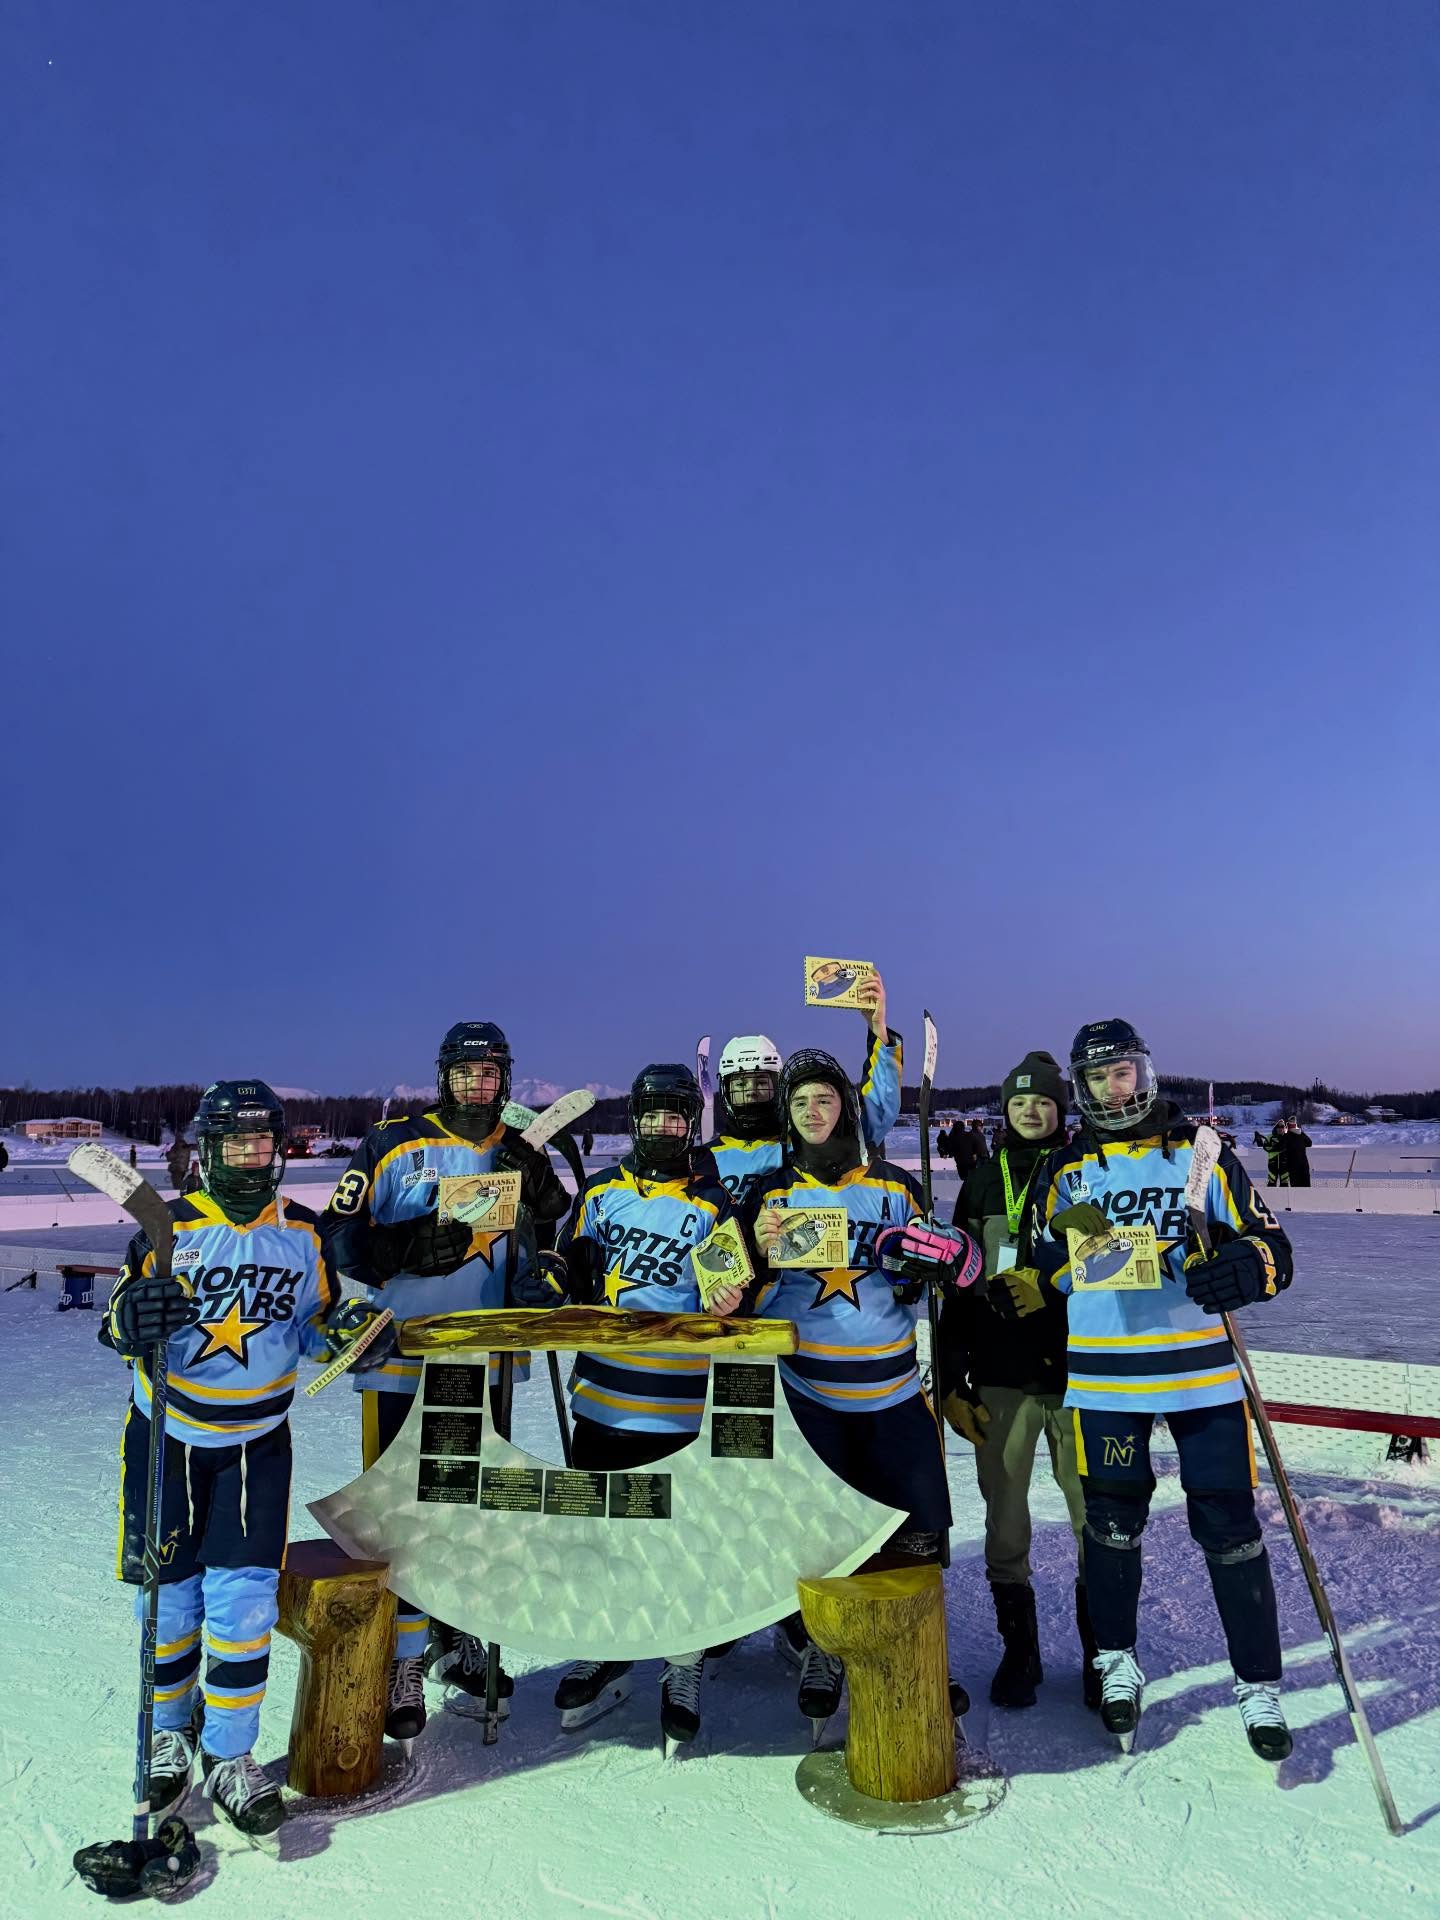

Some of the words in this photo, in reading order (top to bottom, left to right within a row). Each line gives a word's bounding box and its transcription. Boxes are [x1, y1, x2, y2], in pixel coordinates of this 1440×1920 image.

[1087, 1044, 1115, 1055] CCM
[881, 1196, 891, 1221] A
[1090, 1187, 1184, 1217] NORT
[680, 1213, 697, 1238] C
[1109, 1208, 1192, 1236] TAR
[180, 1264, 304, 1295] NORTH
[605, 1247, 683, 1286] TARS
